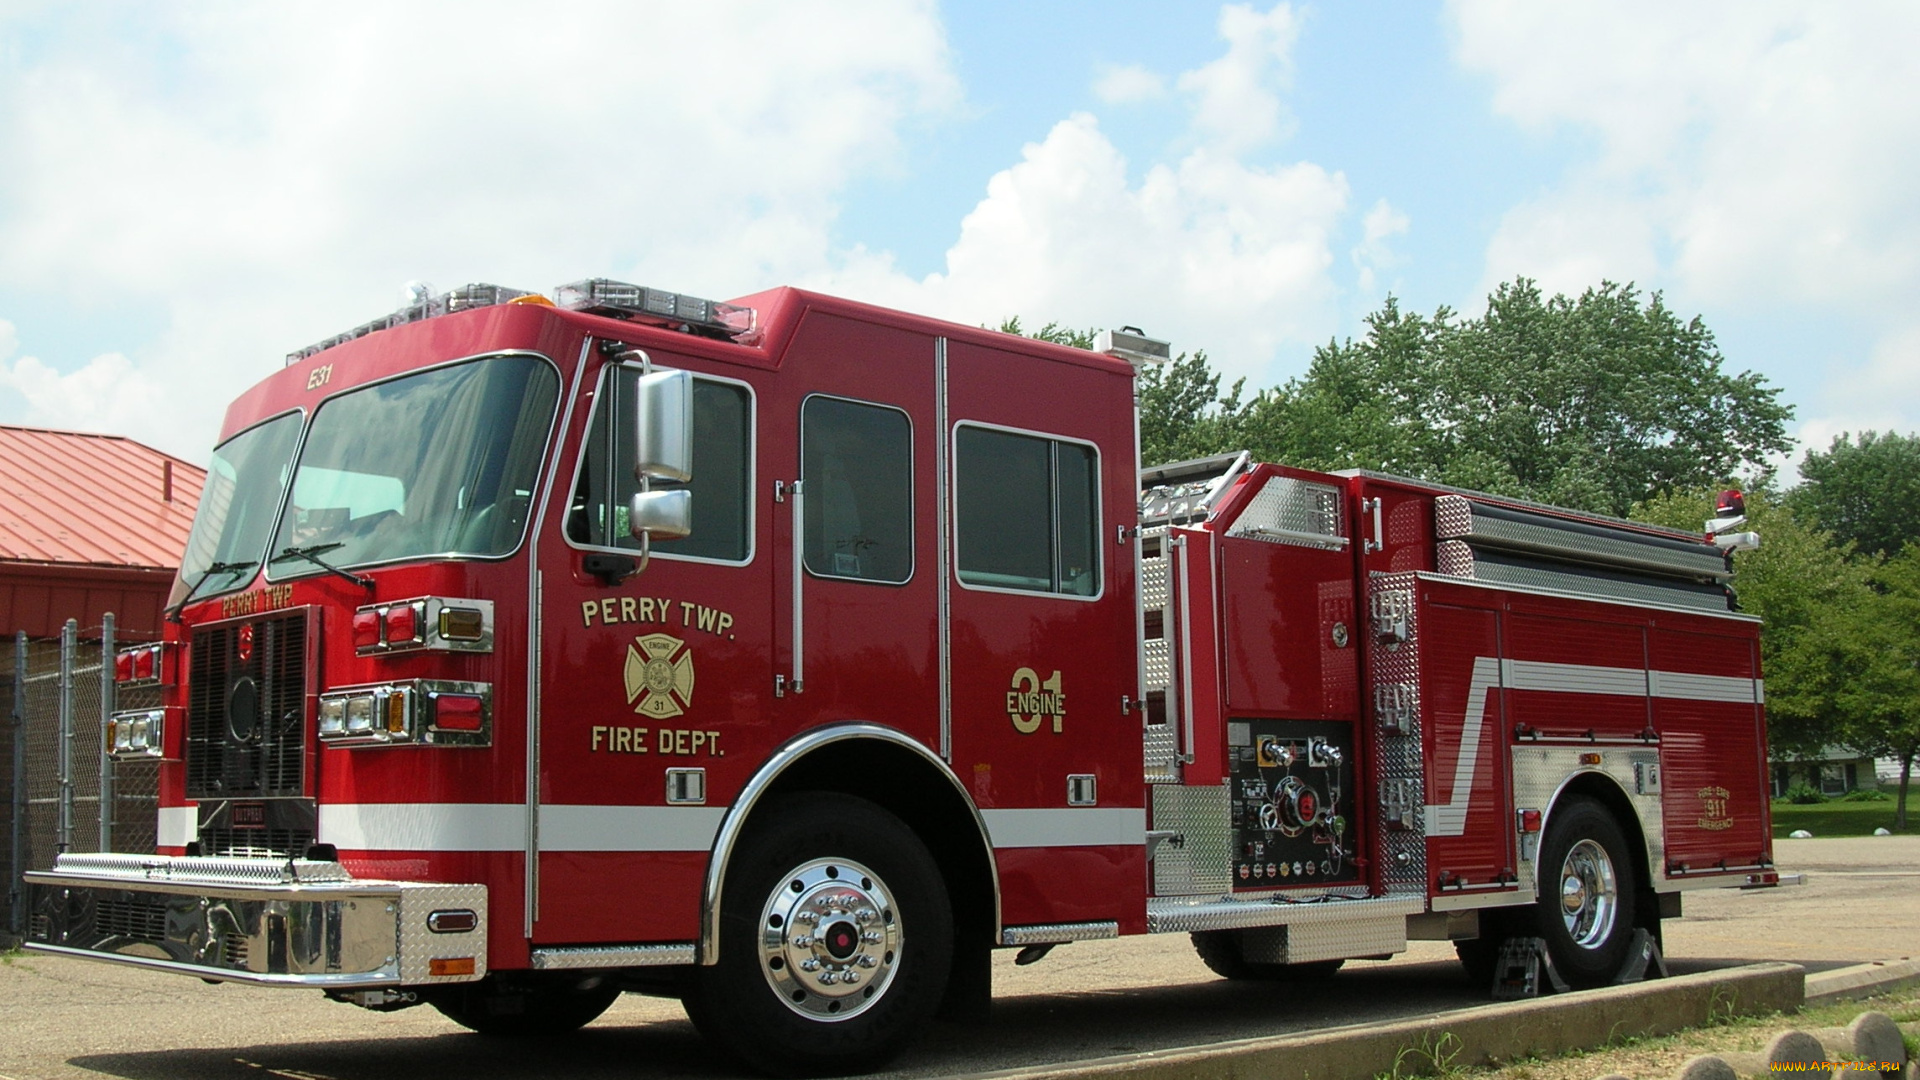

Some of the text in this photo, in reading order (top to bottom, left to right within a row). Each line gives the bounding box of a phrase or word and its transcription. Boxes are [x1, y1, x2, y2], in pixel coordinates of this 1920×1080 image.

[307, 363, 333, 390] E31
[223, 583, 295, 619] PERRY TWP.
[582, 597, 735, 640] PERRY TWP.
[648, 641, 670, 650] ENGINE
[654, 700, 664, 711] 31
[1006, 691, 1067, 714] ENGINE
[1011, 667, 1063, 734] 31
[592, 725, 725, 756] FIRE DEPT.
[1707, 799, 1726, 817] 911
[1697, 816, 1734, 831] EMERGENCY
